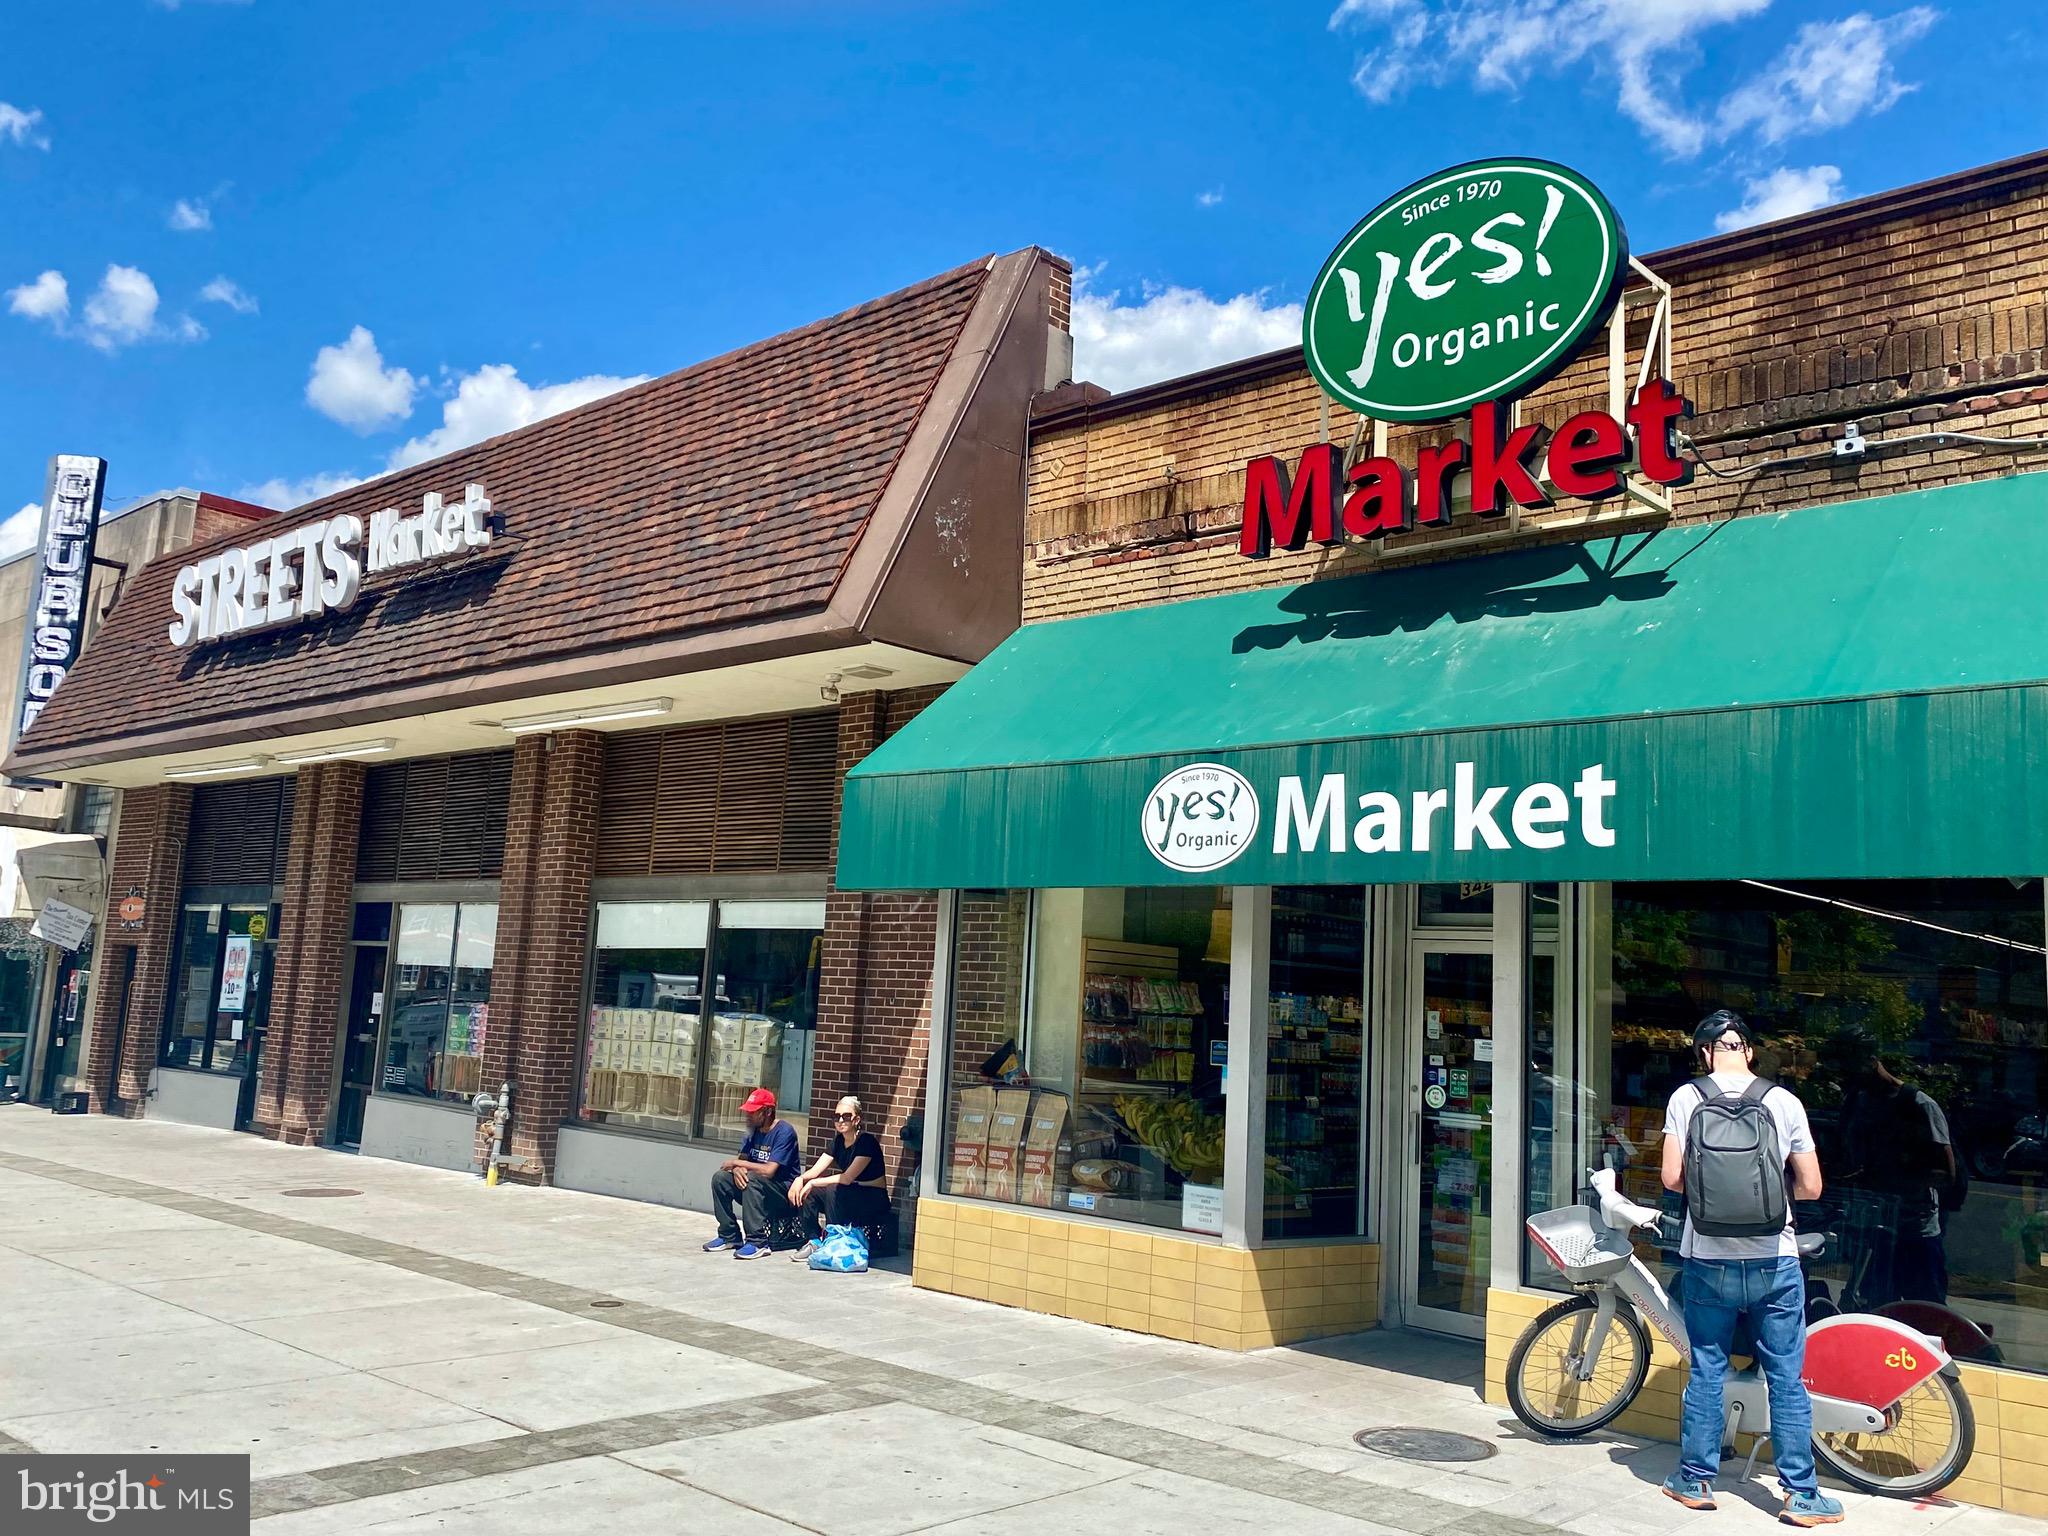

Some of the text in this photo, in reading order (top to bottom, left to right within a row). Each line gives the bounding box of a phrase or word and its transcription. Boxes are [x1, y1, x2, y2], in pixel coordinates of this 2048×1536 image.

[1401, 179, 1502, 226] Since 1970
[1338, 185, 1565, 389] yes!
[1392, 300, 1560, 368] Organic
[1240, 377, 1692, 558] Market
[169, 483, 490, 648] STREETS Market
[1181, 772, 1219, 784] Since 1970
[1272, 761, 1616, 854] Market
[1156, 782, 1240, 852] yes!
[1176, 830, 1238, 850] Organic
[1632, 1292, 1664, 1325] capital
